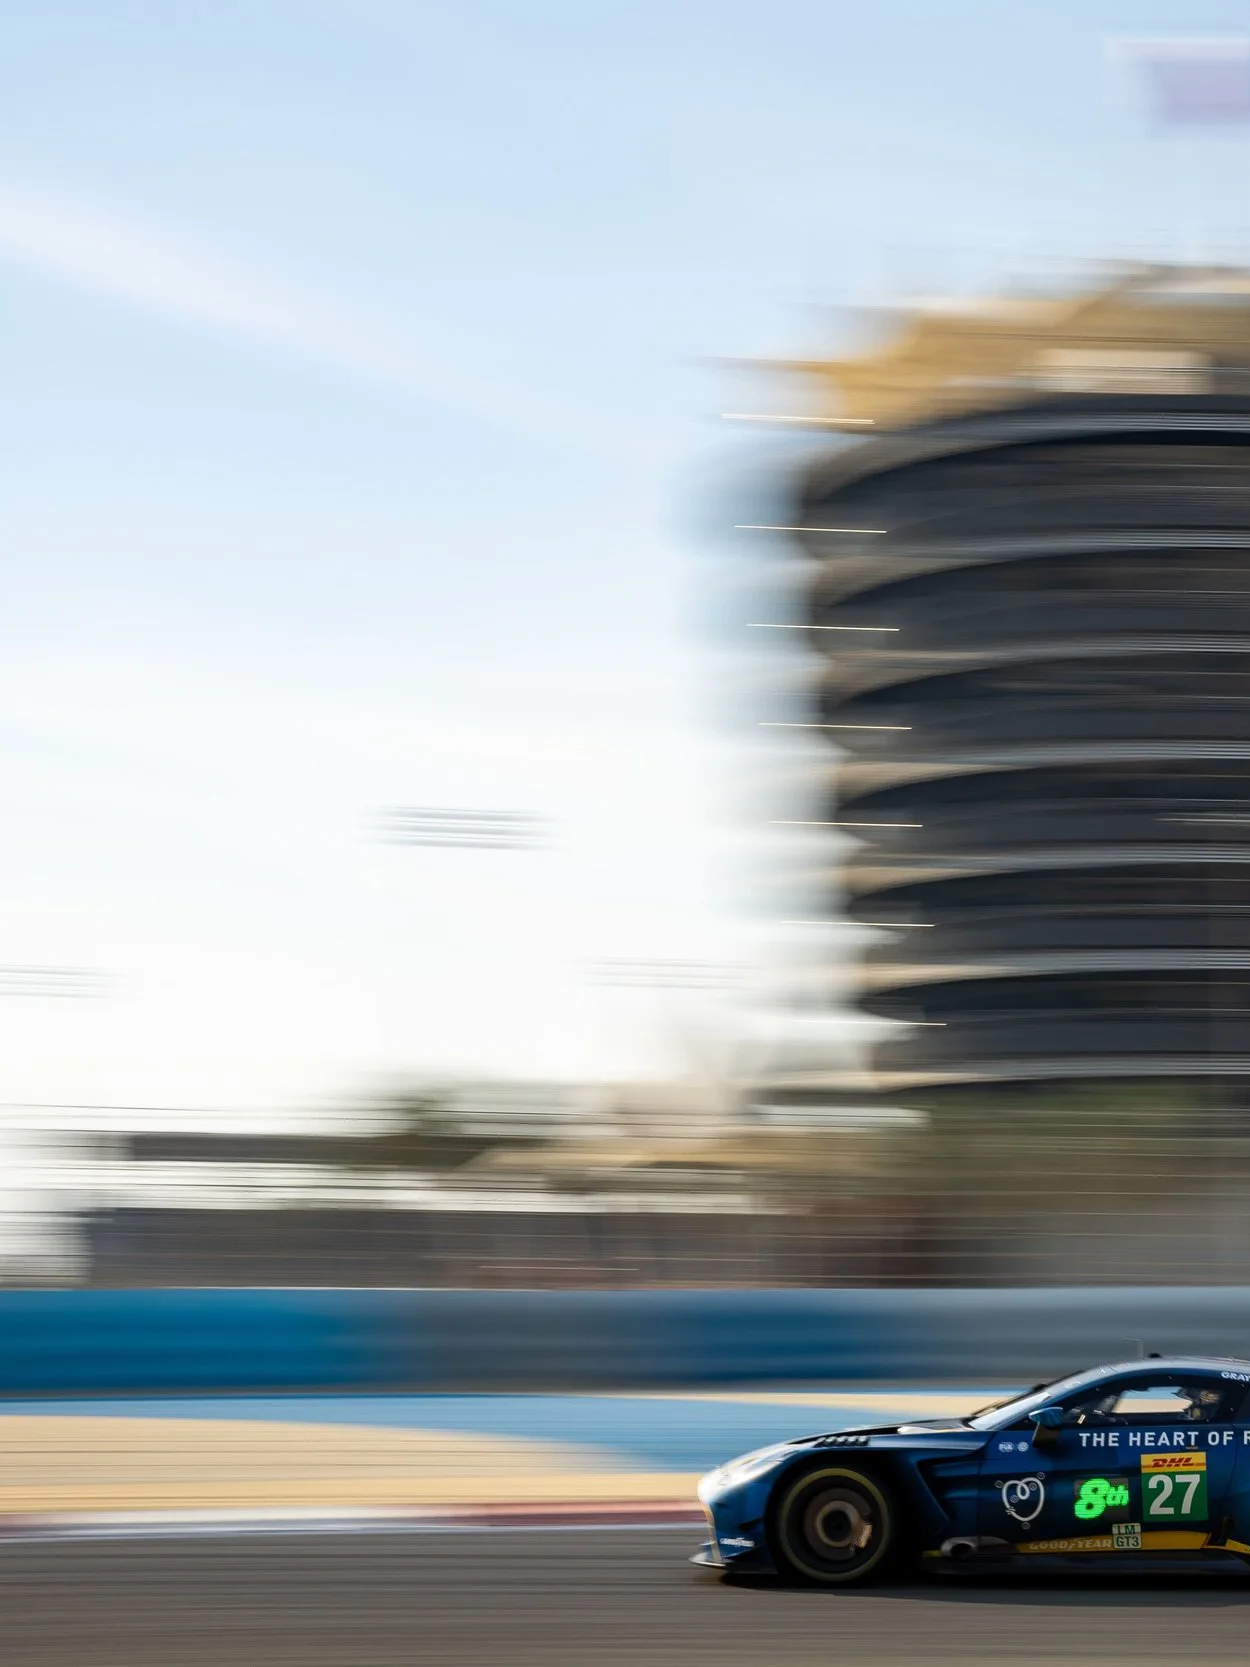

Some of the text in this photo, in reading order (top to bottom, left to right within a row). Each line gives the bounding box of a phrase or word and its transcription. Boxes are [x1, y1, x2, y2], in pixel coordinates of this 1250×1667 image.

[1078, 1432, 1120, 1447] THE
[1128, 1431, 1199, 1447] HEART
[1207, 1431, 1234, 1446] OF
[1151, 1457, 1194, 1468] DHL
[1074, 1478, 1129, 1519] 8th
[1148, 1474, 1200, 1515] 27
[1117, 1524, 1136, 1535] LM
[1029, 1539, 1112, 1552] GOODYEAR
[1116, 1536, 1139, 1547] GT3
